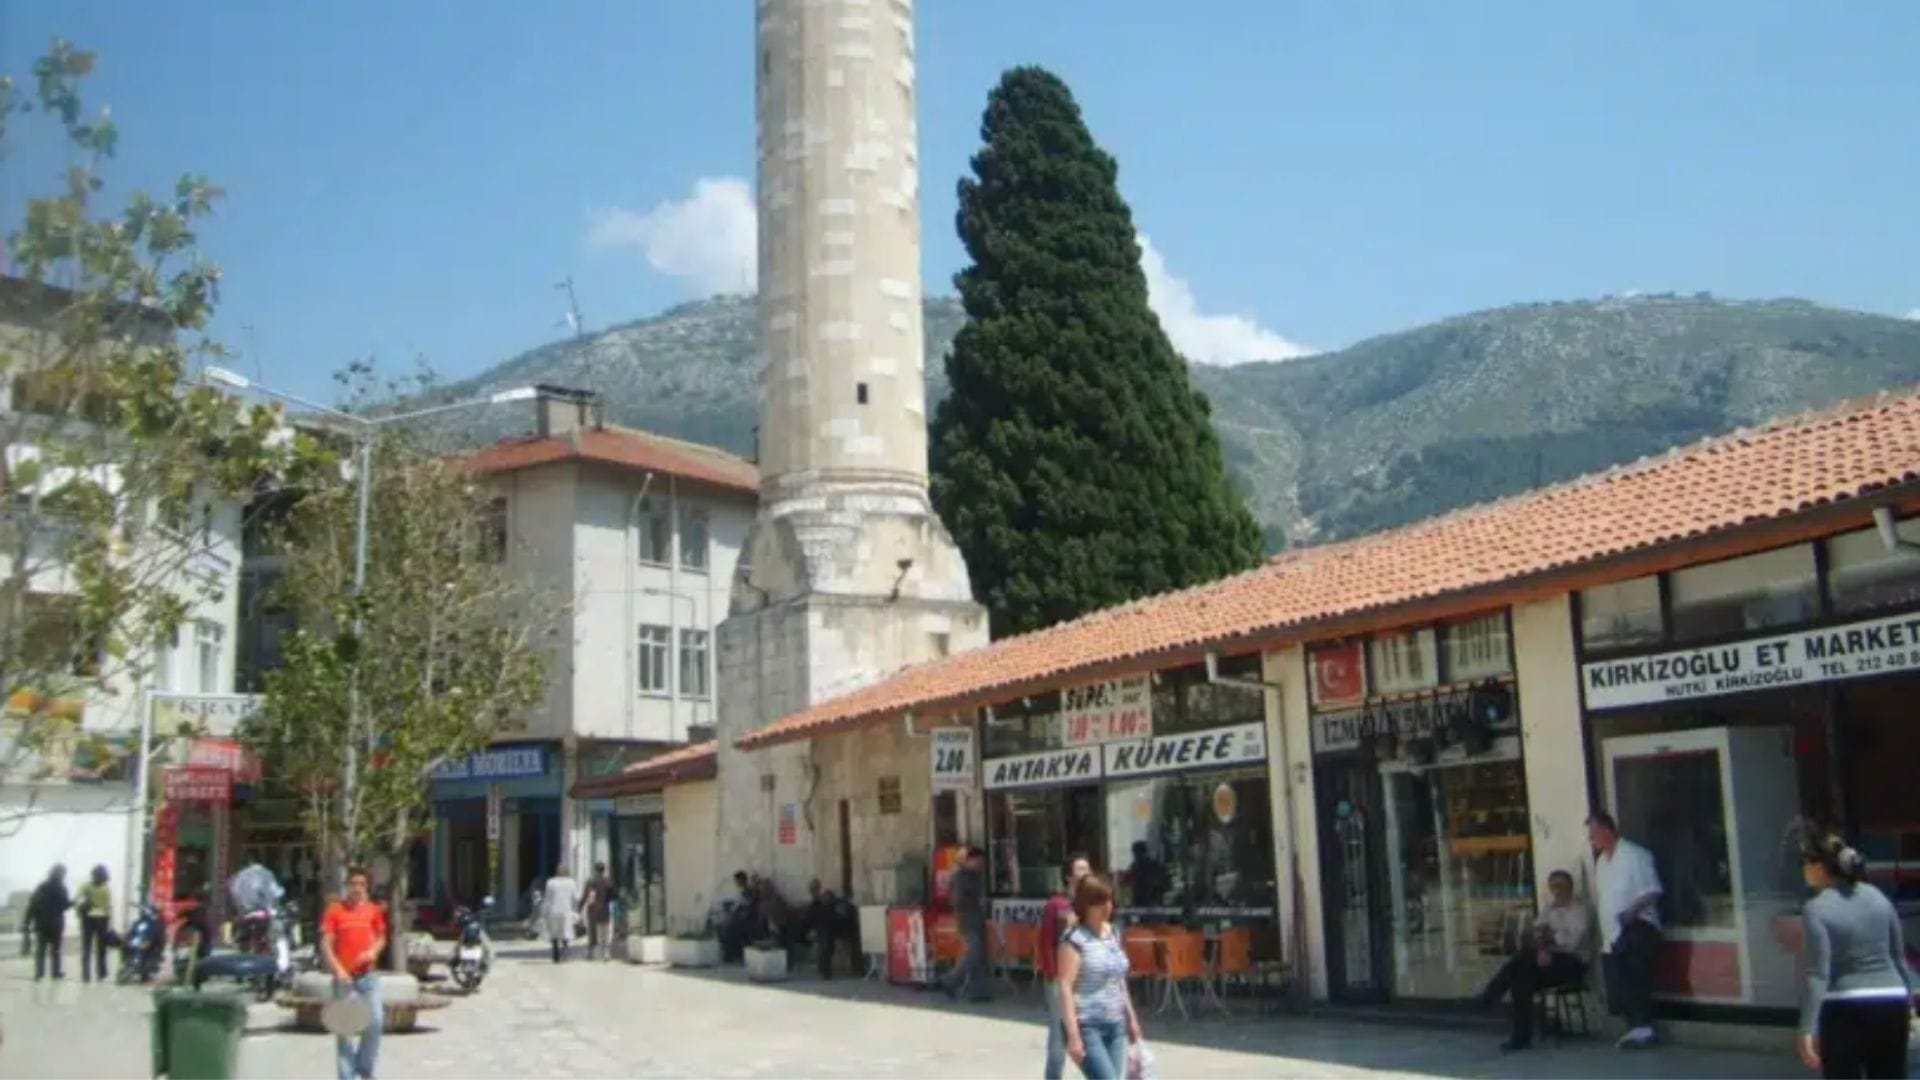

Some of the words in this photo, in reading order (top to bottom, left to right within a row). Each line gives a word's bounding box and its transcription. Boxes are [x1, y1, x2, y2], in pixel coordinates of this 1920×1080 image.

[1757, 641, 1788, 667] ET
[1804, 620, 1920, 660] MARKET
[1820, 661, 1847, 676] TEL
[994, 751, 1092, 784] ANTAKYA
[1113, 732, 1234, 770] KÜNEFE
